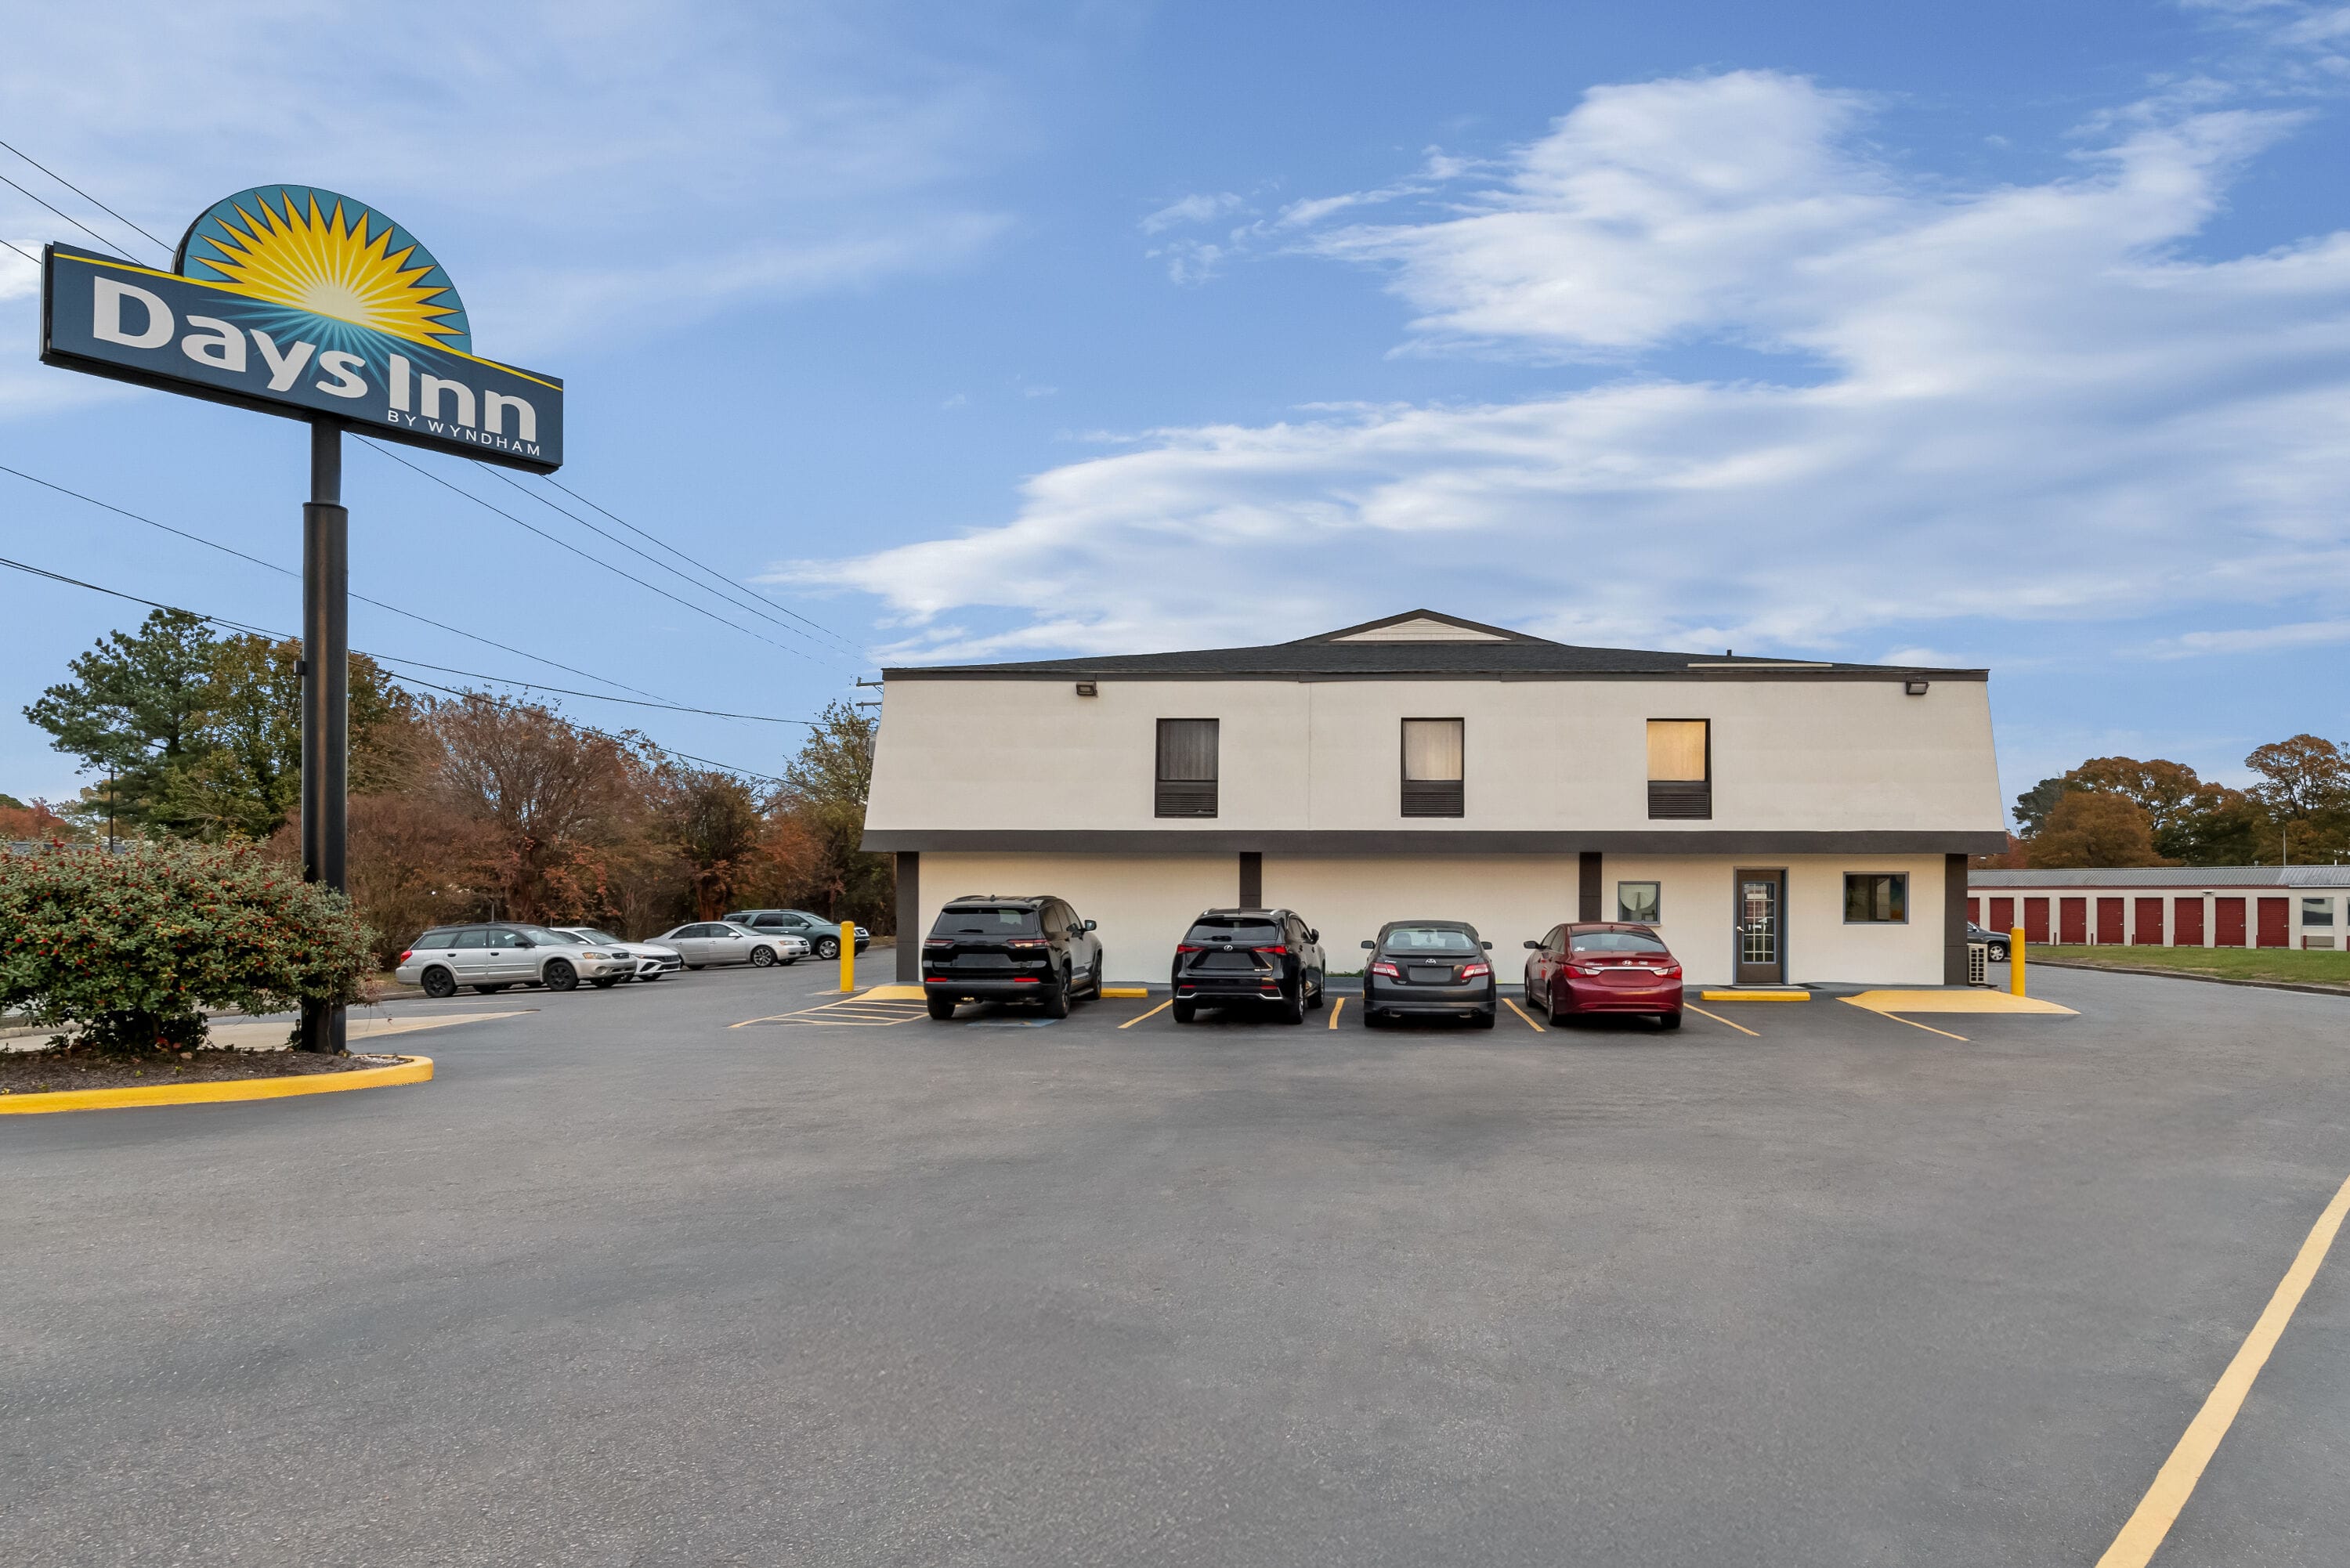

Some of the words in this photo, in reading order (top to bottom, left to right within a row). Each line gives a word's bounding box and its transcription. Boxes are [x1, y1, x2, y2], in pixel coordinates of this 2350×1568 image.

[93, 275, 369, 399] Days
[389, 352, 537, 443] Inn
[387, 410, 417, 427] BY
[427, 419, 540, 457] WYNDHAM
